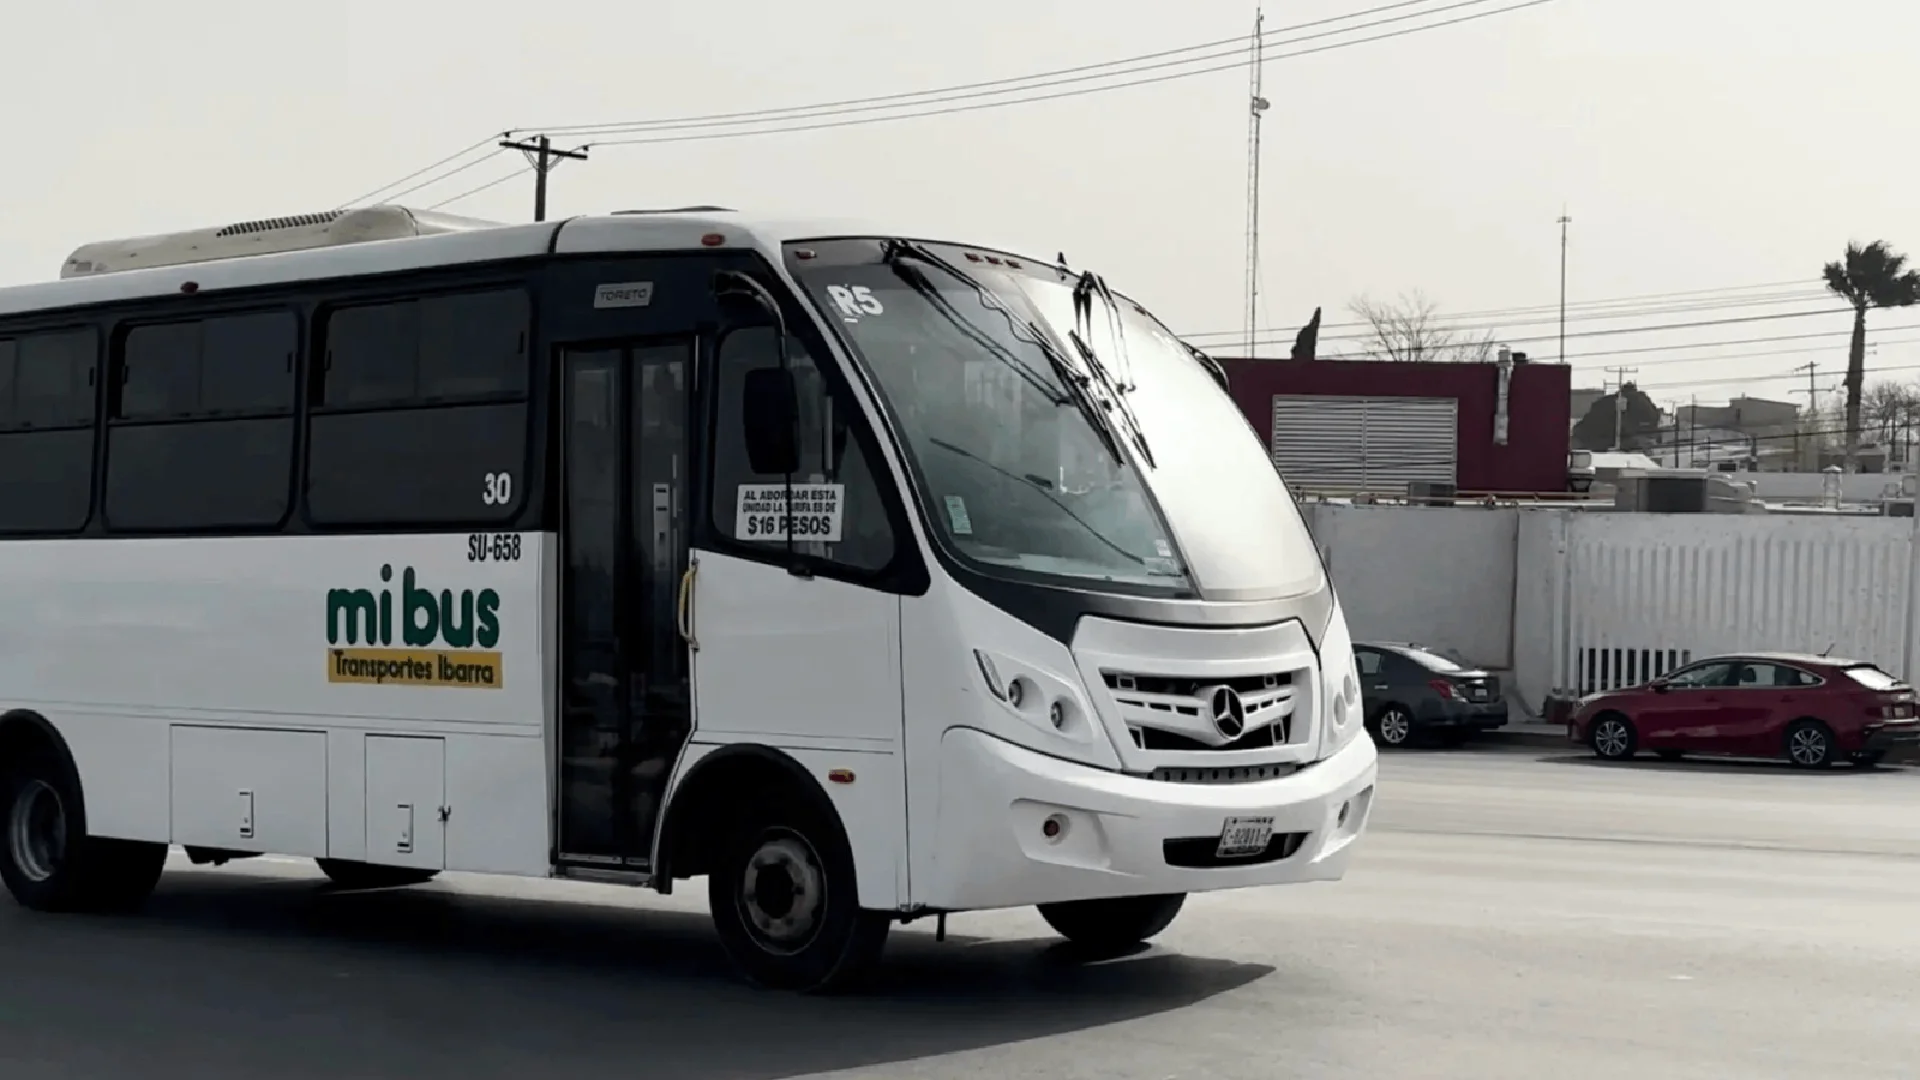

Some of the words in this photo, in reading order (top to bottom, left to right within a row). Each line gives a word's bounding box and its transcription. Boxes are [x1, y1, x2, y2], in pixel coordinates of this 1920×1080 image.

[827, 285, 884, 315] R5
[483, 472, 511, 505] 30
[744, 490, 757, 500] AL
[760, 490, 809, 500] ABORAR
[811, 490, 836, 500] ESTA
[743, 503, 771, 512] UNIDAD
[773, 503, 782, 512] LA
[786, 503, 810, 512] ARIFA
[813, 503, 824, 512] ES
[825, 503, 836, 512] DE
[779, 516, 831, 535] PESOS
[468, 533, 521, 562] SU-658
[327, 563, 393, 646] mi
[403, 565, 500, 648] bus
[333, 650, 432, 684] Transportes
[437, 654, 494, 684] Ibarra
